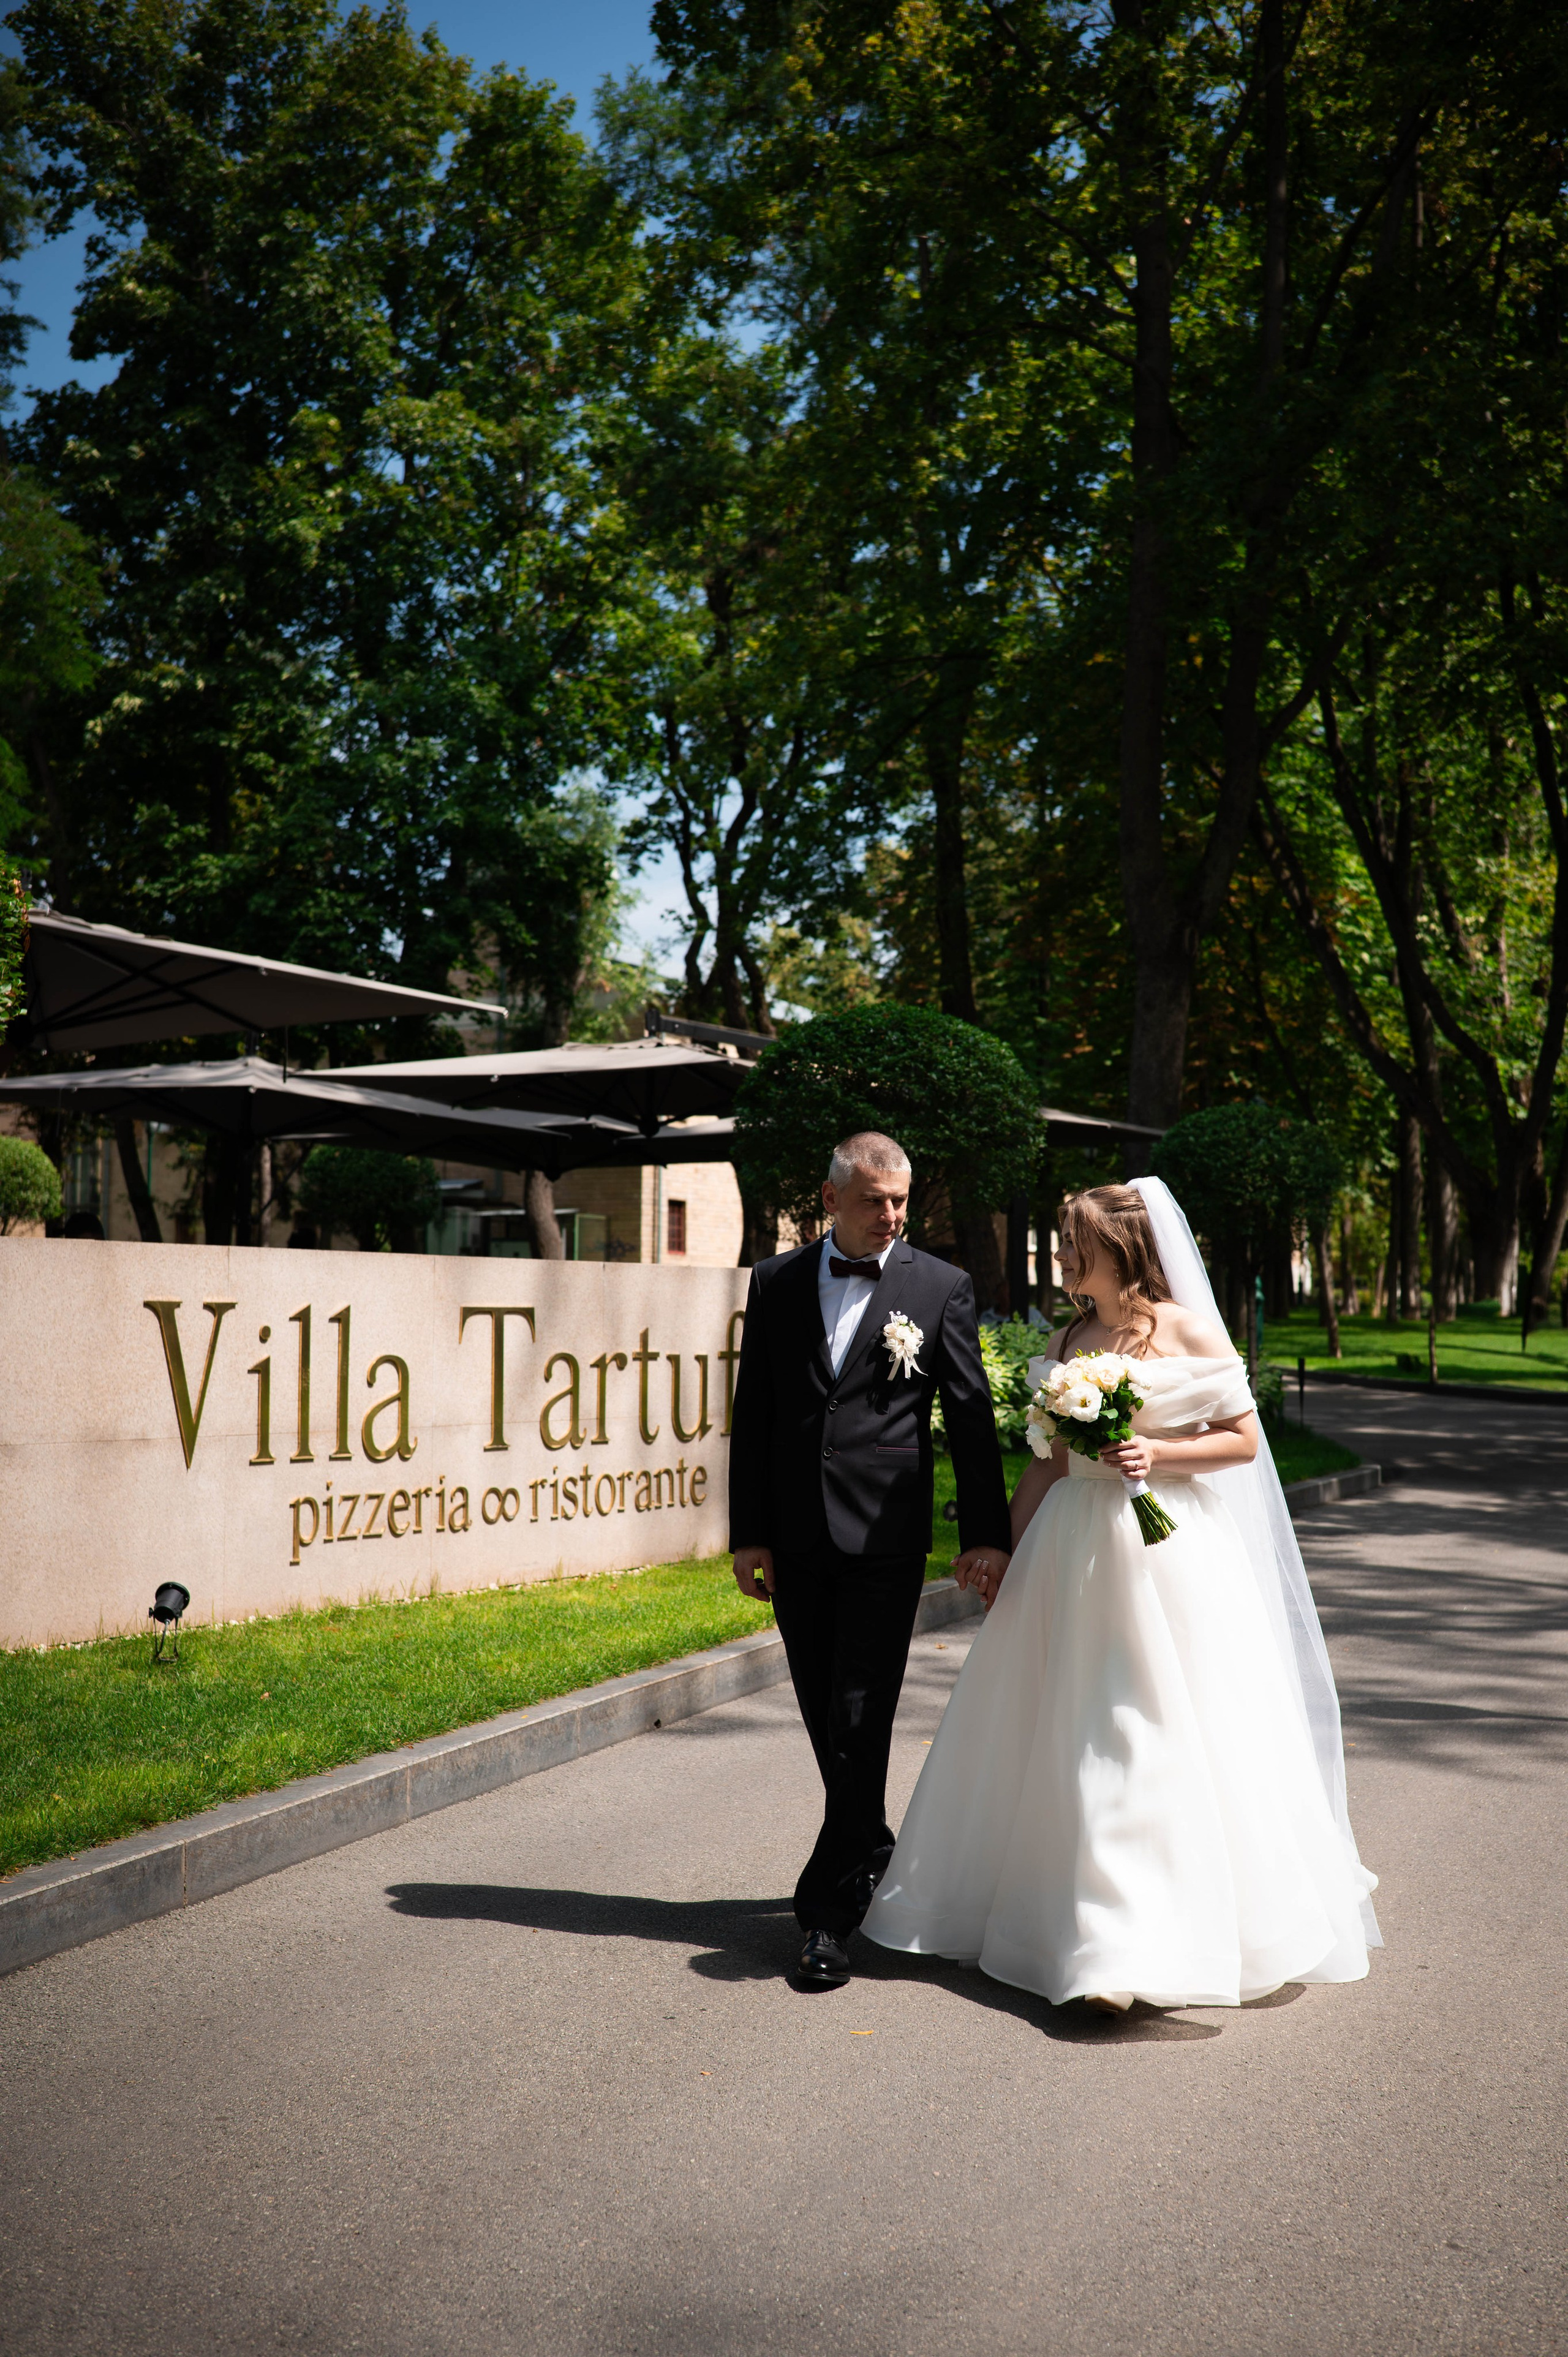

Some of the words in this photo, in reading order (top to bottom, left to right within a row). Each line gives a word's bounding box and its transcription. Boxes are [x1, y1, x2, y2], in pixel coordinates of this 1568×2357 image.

[143, 1300, 418, 1472] Villa
[289, 1475, 472, 1566] pizzeria
[529, 1457, 708, 1523] ristorante
